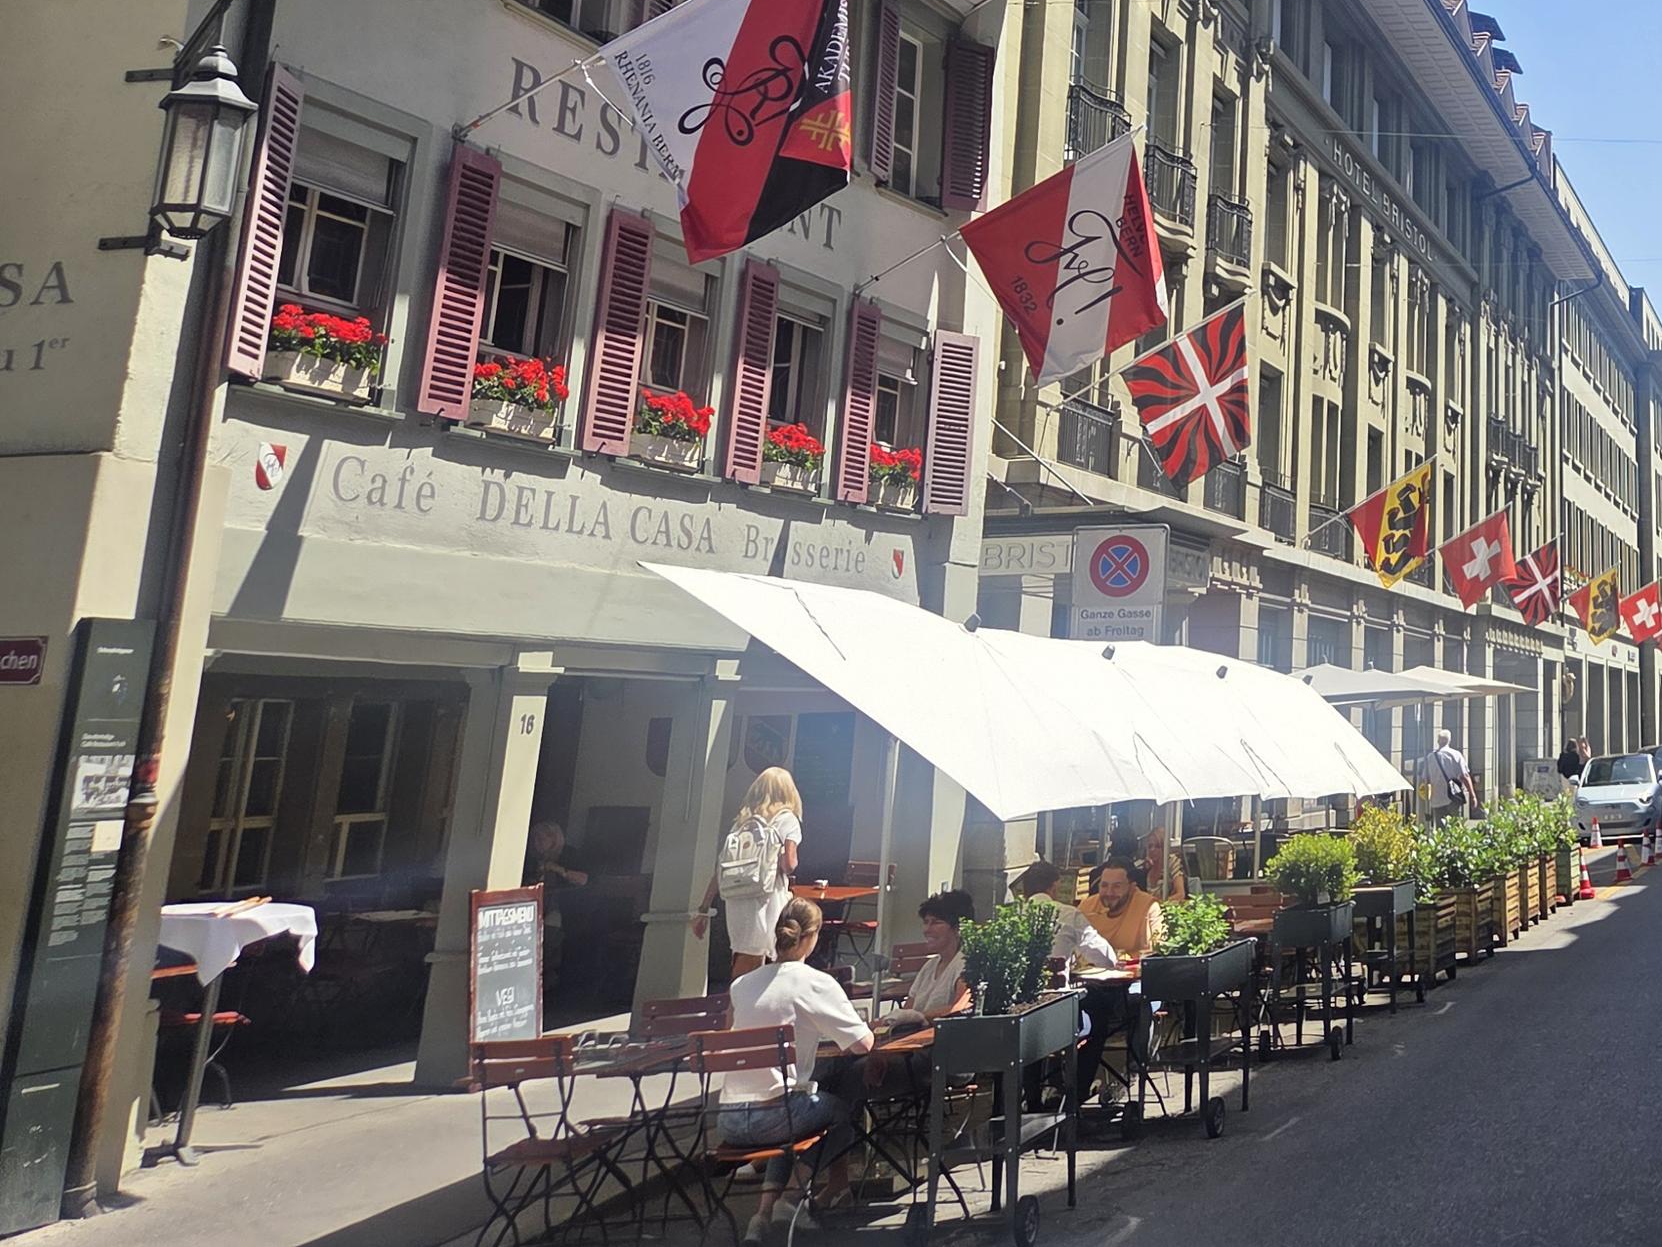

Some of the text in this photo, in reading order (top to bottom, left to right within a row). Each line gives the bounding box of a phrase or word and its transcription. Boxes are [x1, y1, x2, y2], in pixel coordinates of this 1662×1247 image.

[634, 53, 656, 87] 1816
[615, 50, 655, 142] RHENANIA
[505, 56, 842, 251] RESTNT
[1009, 276, 1038, 313] 1832
[332, 455, 867, 574] Café DELLA CASA Brsserie
[982, 540, 1072, 570] BRIST
[1080, 608, 1152, 620] Ganze Gasse
[1104, 625, 1145, 638] Freitag
[520, 713, 536, 735] 16
